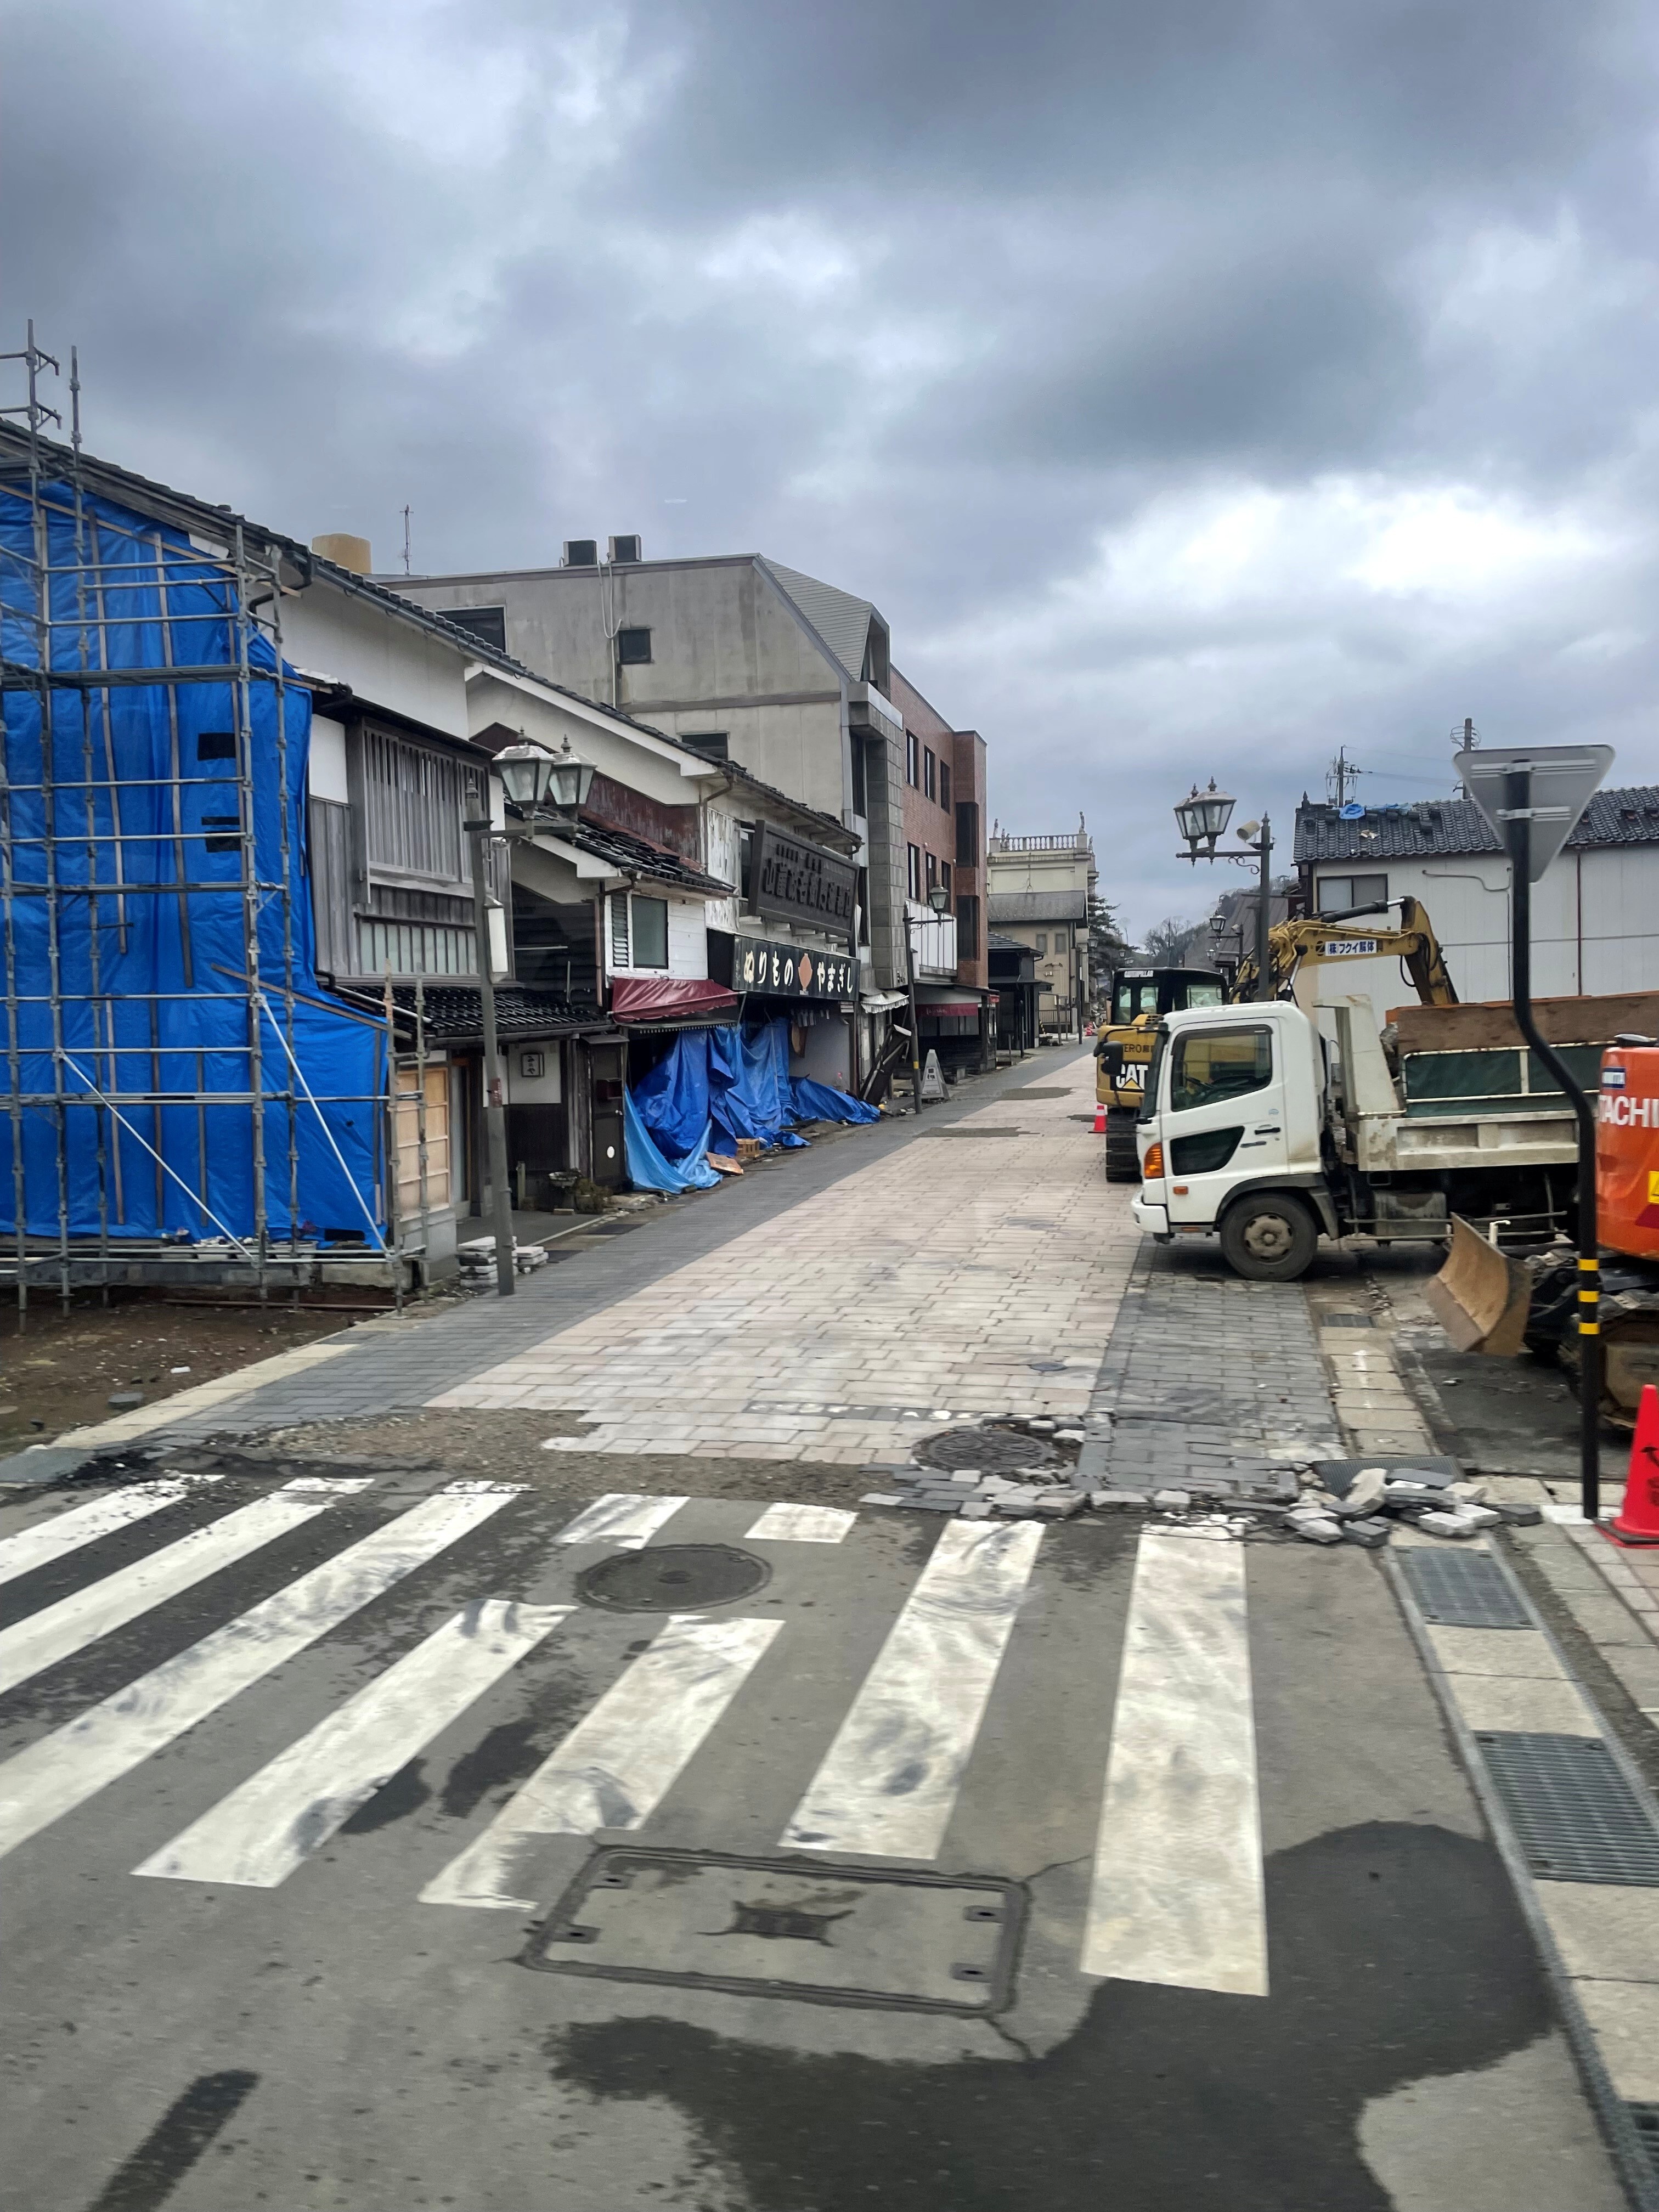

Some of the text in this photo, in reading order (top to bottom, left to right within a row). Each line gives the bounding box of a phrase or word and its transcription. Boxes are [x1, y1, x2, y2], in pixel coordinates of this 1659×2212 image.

[817, 961, 853, 993] やまぎし
[1123, 1043, 1142, 1053] ERO
[1116, 1064, 1149, 1090] CAT
[1598, 1095, 1659, 1127] TACHI
